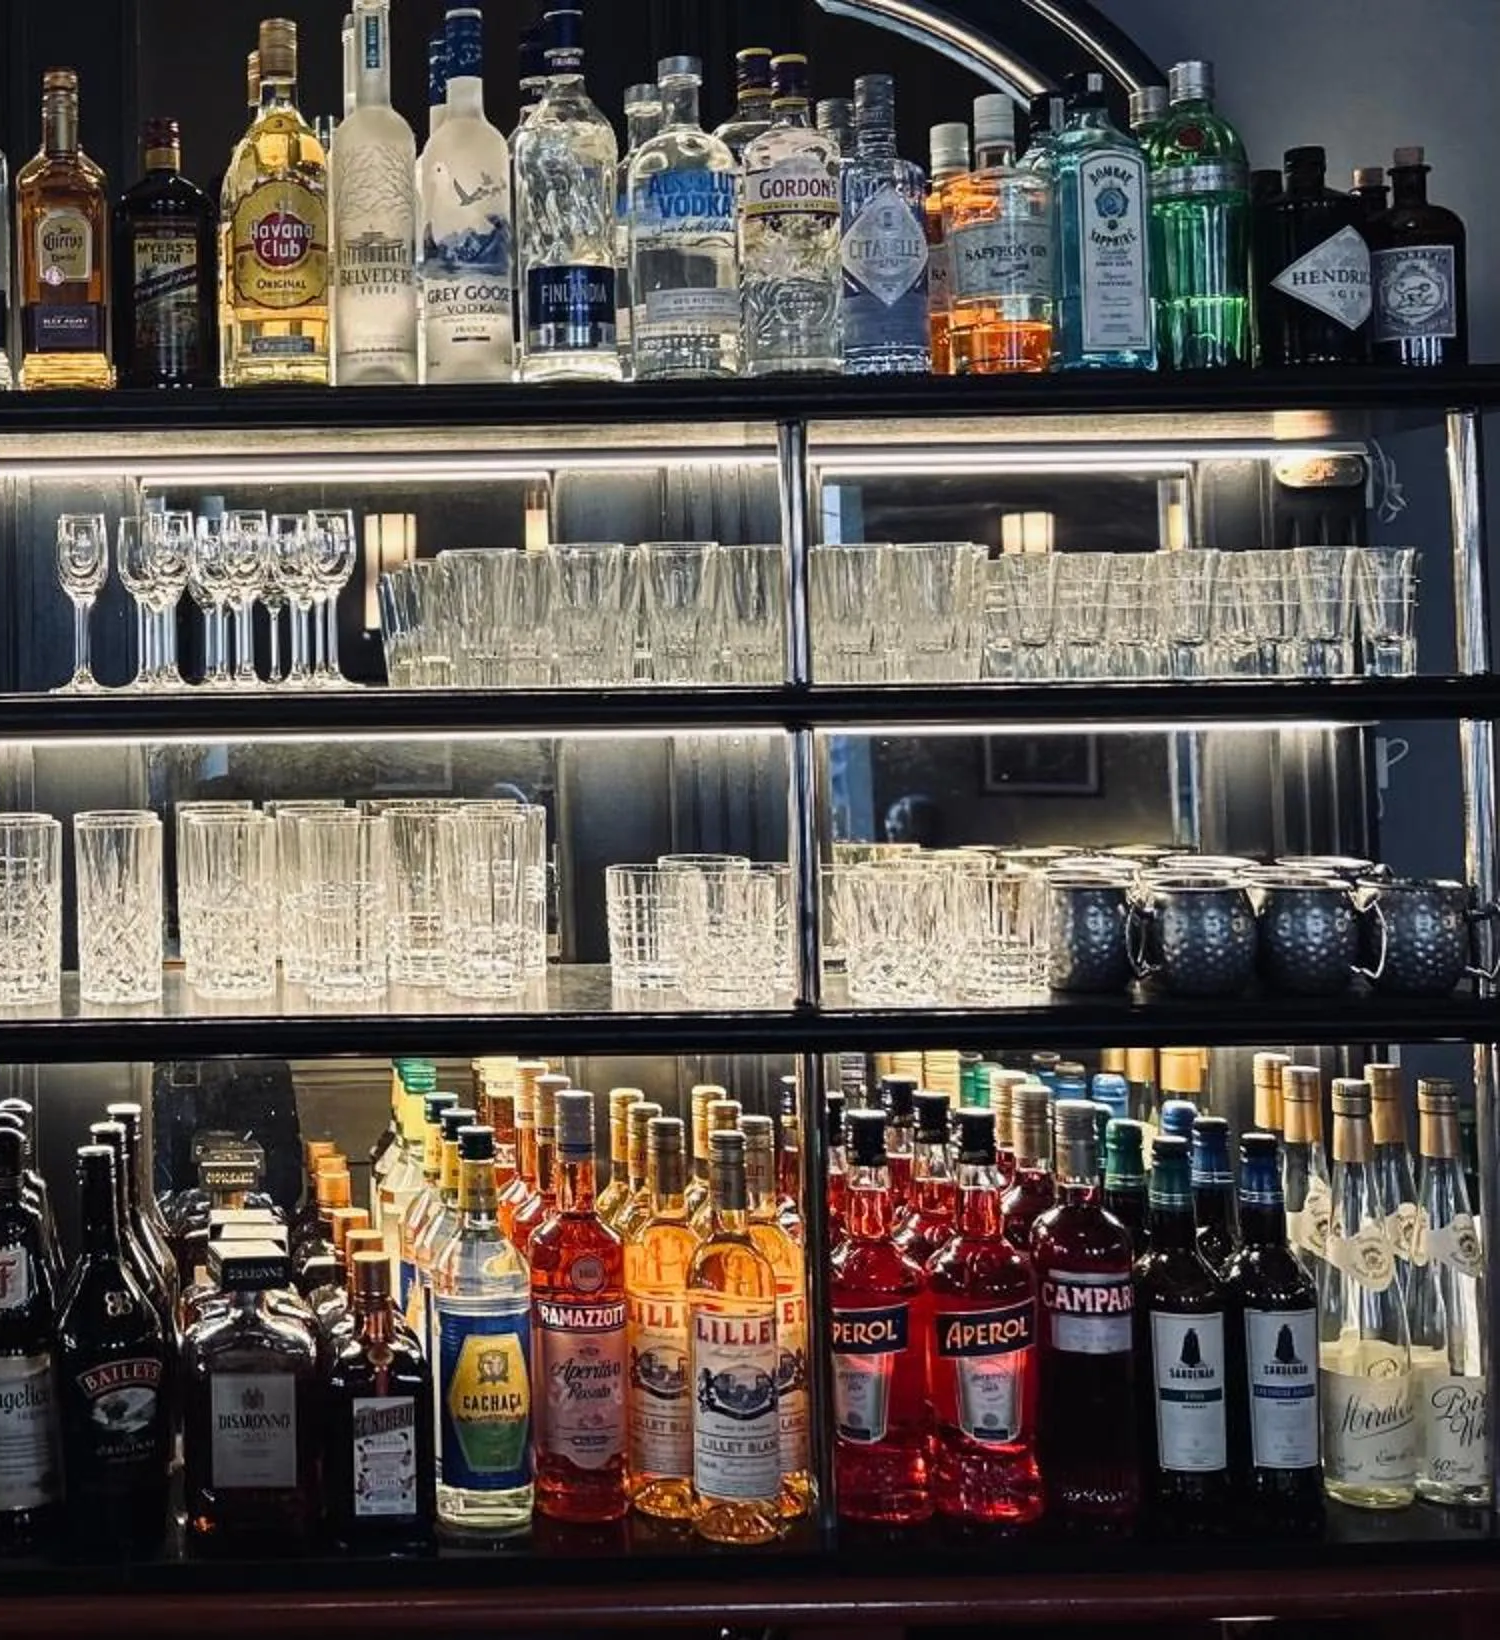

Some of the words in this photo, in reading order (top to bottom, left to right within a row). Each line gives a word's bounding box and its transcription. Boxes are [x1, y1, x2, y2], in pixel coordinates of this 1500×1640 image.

[1089, 166, 1133, 187] BOMBAY
[660, 194, 732, 219] VODKA
[261, 240, 300, 258] Club
[151, 254, 181, 265] RUM
[428, 286, 460, 304] GREY
[542, 283, 608, 305] FINLANDIA
[447, 303, 496, 315] VODKA
[946, 1316, 1029, 1349] APEROL
[84, 1363, 159, 1394] BAILEYS
[463, 1394, 523, 1413] CACHAÇA
[218, 1413, 291, 1430] DISARONNO
